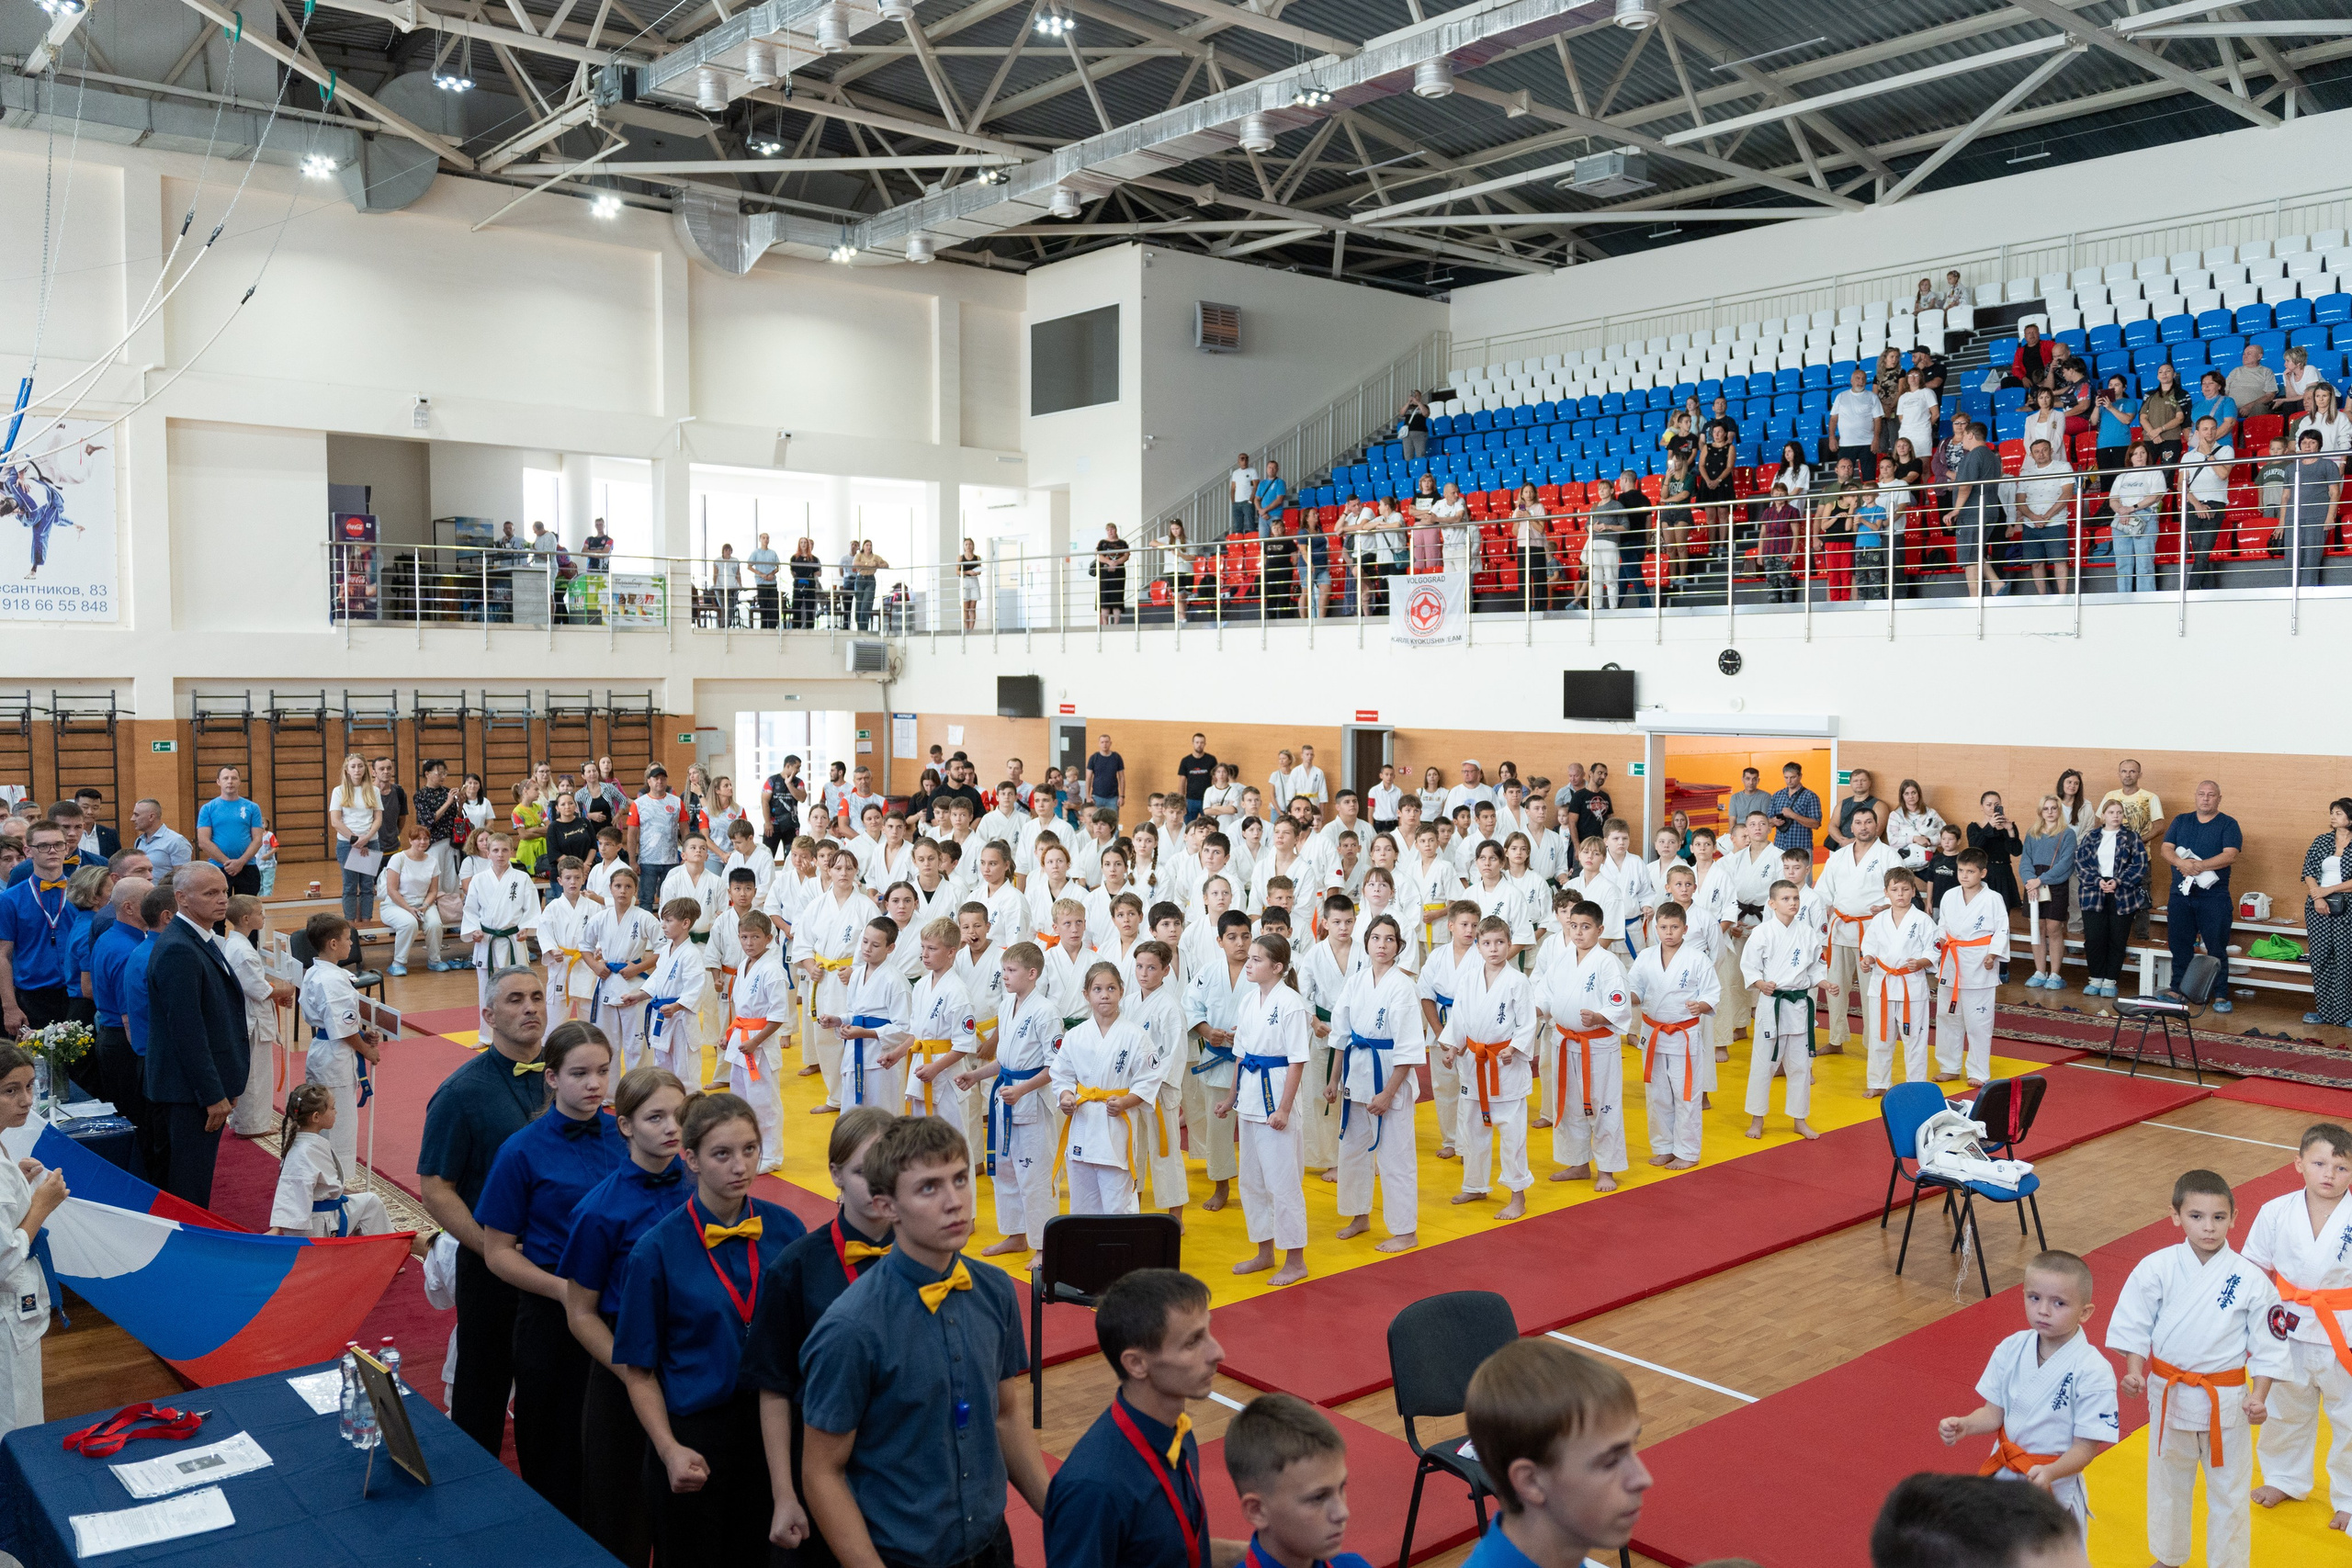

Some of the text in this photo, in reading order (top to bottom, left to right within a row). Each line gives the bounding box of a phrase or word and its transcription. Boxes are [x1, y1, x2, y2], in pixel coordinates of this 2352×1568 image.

[1407, 575, 1446, 584] VOLGOGRAD
[0, 584, 107, 597] сантников, 83
[2, 598, 107, 613] 918 66 55 848
